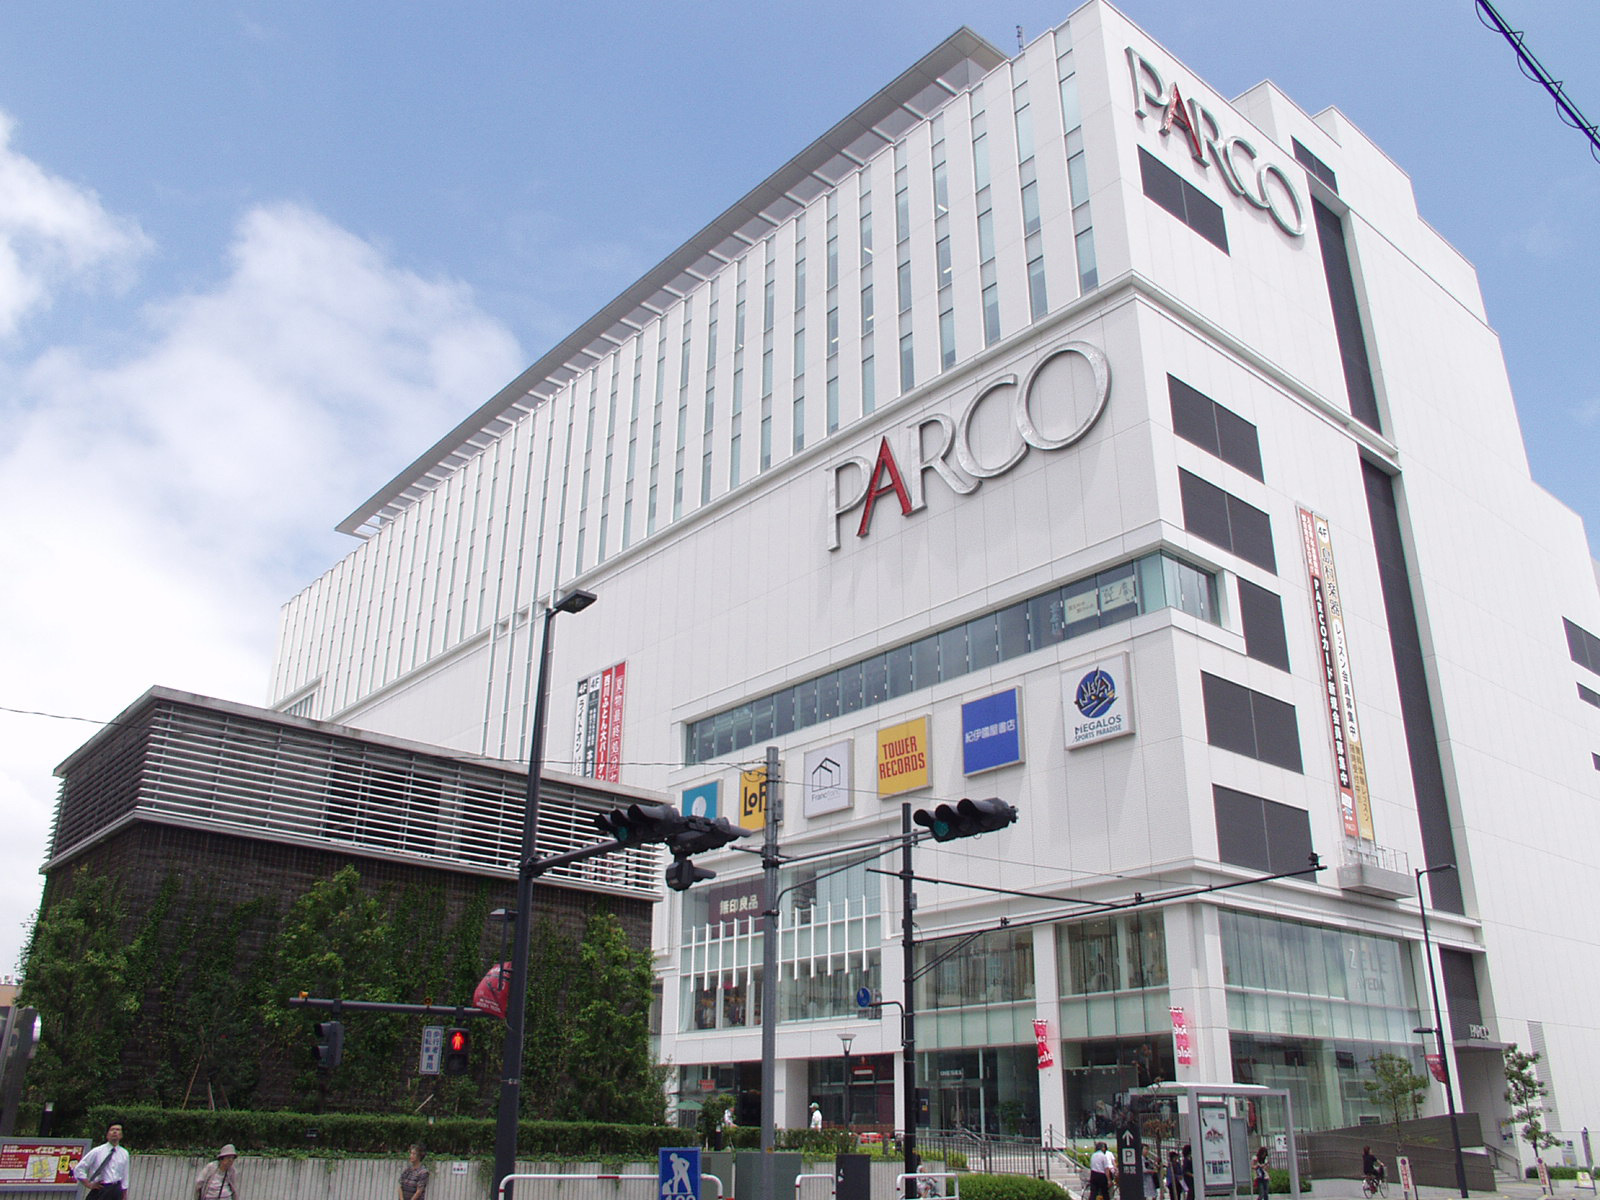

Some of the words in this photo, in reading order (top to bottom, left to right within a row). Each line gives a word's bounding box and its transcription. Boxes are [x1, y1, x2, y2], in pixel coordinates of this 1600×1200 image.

[1124, 46, 1307, 236] PARCO
[824, 340, 1112, 551] PARCO
[1073, 731, 1095, 743] SPORTS
[1096, 724, 1121, 736] PARADISE
[1074, 714, 1122, 735] MEGALOS
[882, 735, 917, 760] TOWER
[879, 752, 926, 780] RECORDS
[719, 895, 759, 915] 無印良品
[1469, 1024, 1490, 1040] PARCO
[1125, 1150, 1133, 1162] P
